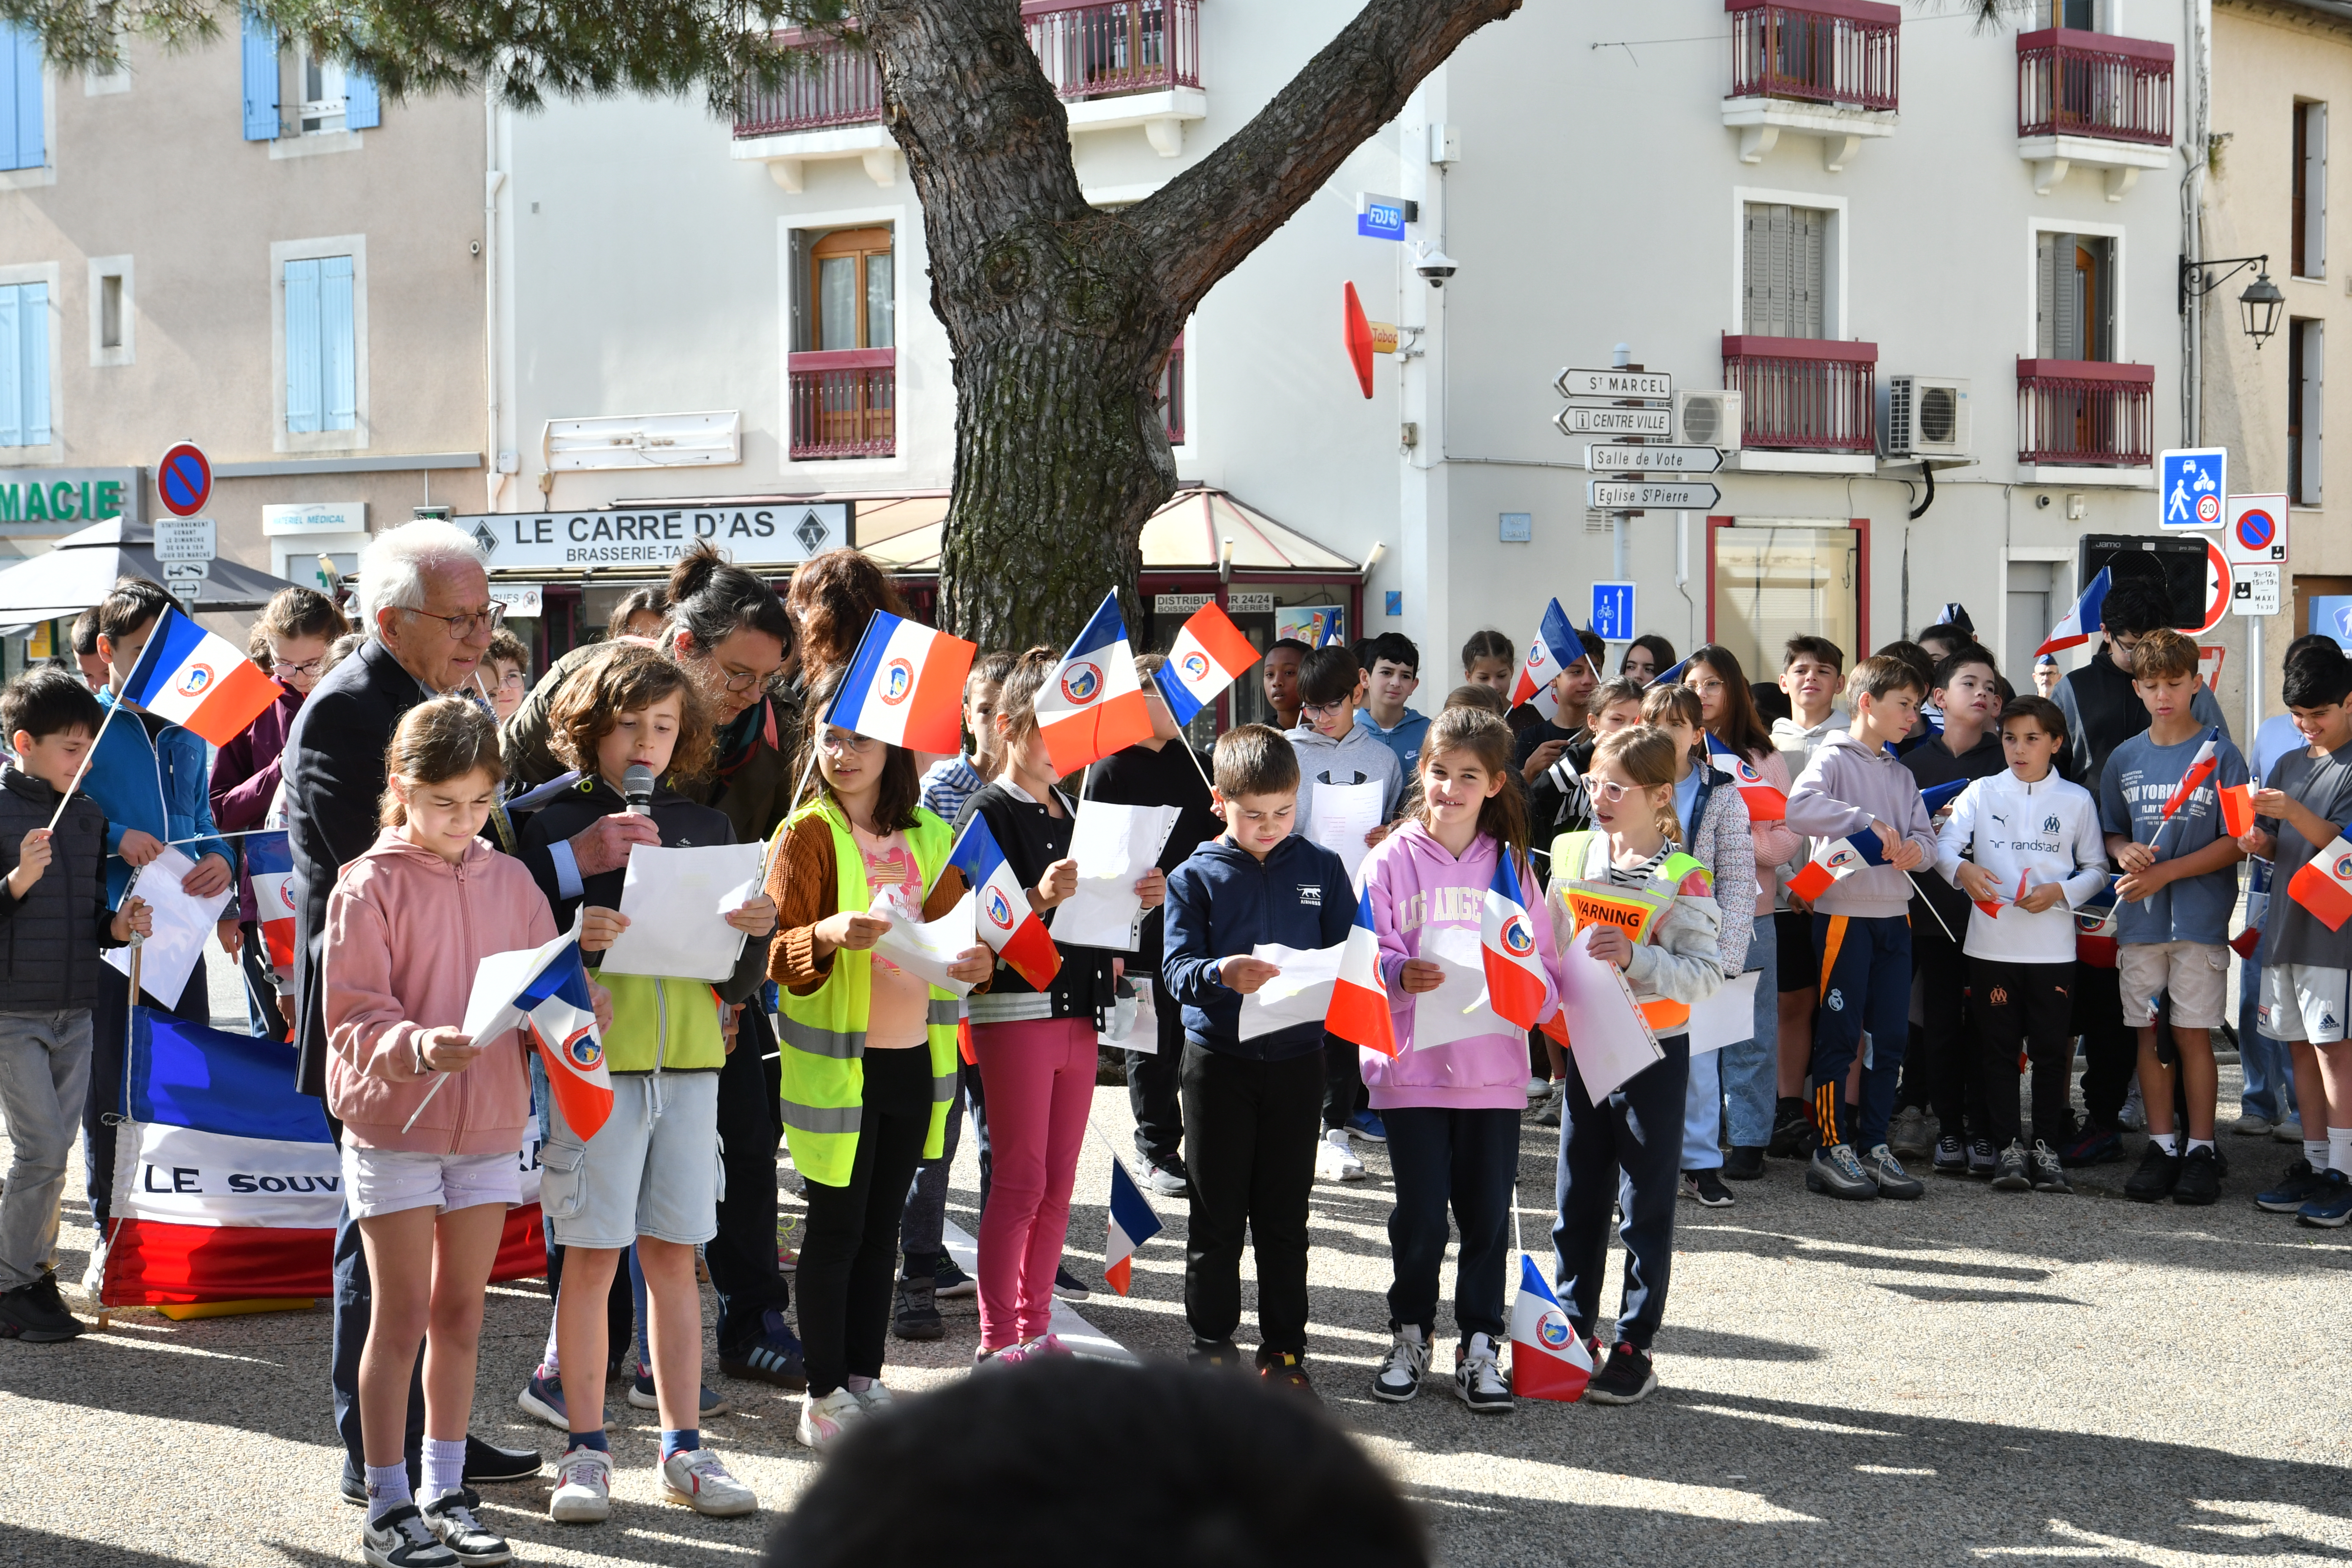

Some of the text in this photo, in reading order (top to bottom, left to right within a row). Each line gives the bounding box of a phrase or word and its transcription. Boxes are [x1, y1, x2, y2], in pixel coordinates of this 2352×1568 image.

[1369, 207, 1389, 225] FDJ
[1372, 327, 1397, 344] Tabac
[1609, 378, 1665, 393] MARCEL
[1593, 413, 1634, 427] CENTRE
[1636, 415, 1665, 429] VILLE
[1598, 451, 1682, 466] Salle de Vote
[1599, 488, 1635, 505] Eglise
[1654, 489, 1688, 502] Pierre
[307, 512, 345, 523] MÉDICAL
[2201, 504, 2214, 514] 20
[515, 518, 553, 544] LE
[1241, 594, 1269, 604] 24/24
[1094, 670, 1103, 694] SOUVENIR
[2142, 784, 2176, 800] YORK
[2188, 786, 2214, 806] TATE
[2012, 839, 2061, 853] randstad
[1000, 893, 1013, 920] SOUVENIR
[1399, 887, 1487, 935] LOS ANGE
[1501, 917, 1516, 939] SOUVENIR
[564, 1029, 585, 1050] SOUVENIR
[144, 1164, 340, 1193] LE SOUV
[1557, 1332, 1574, 1350] SOUVENIR
